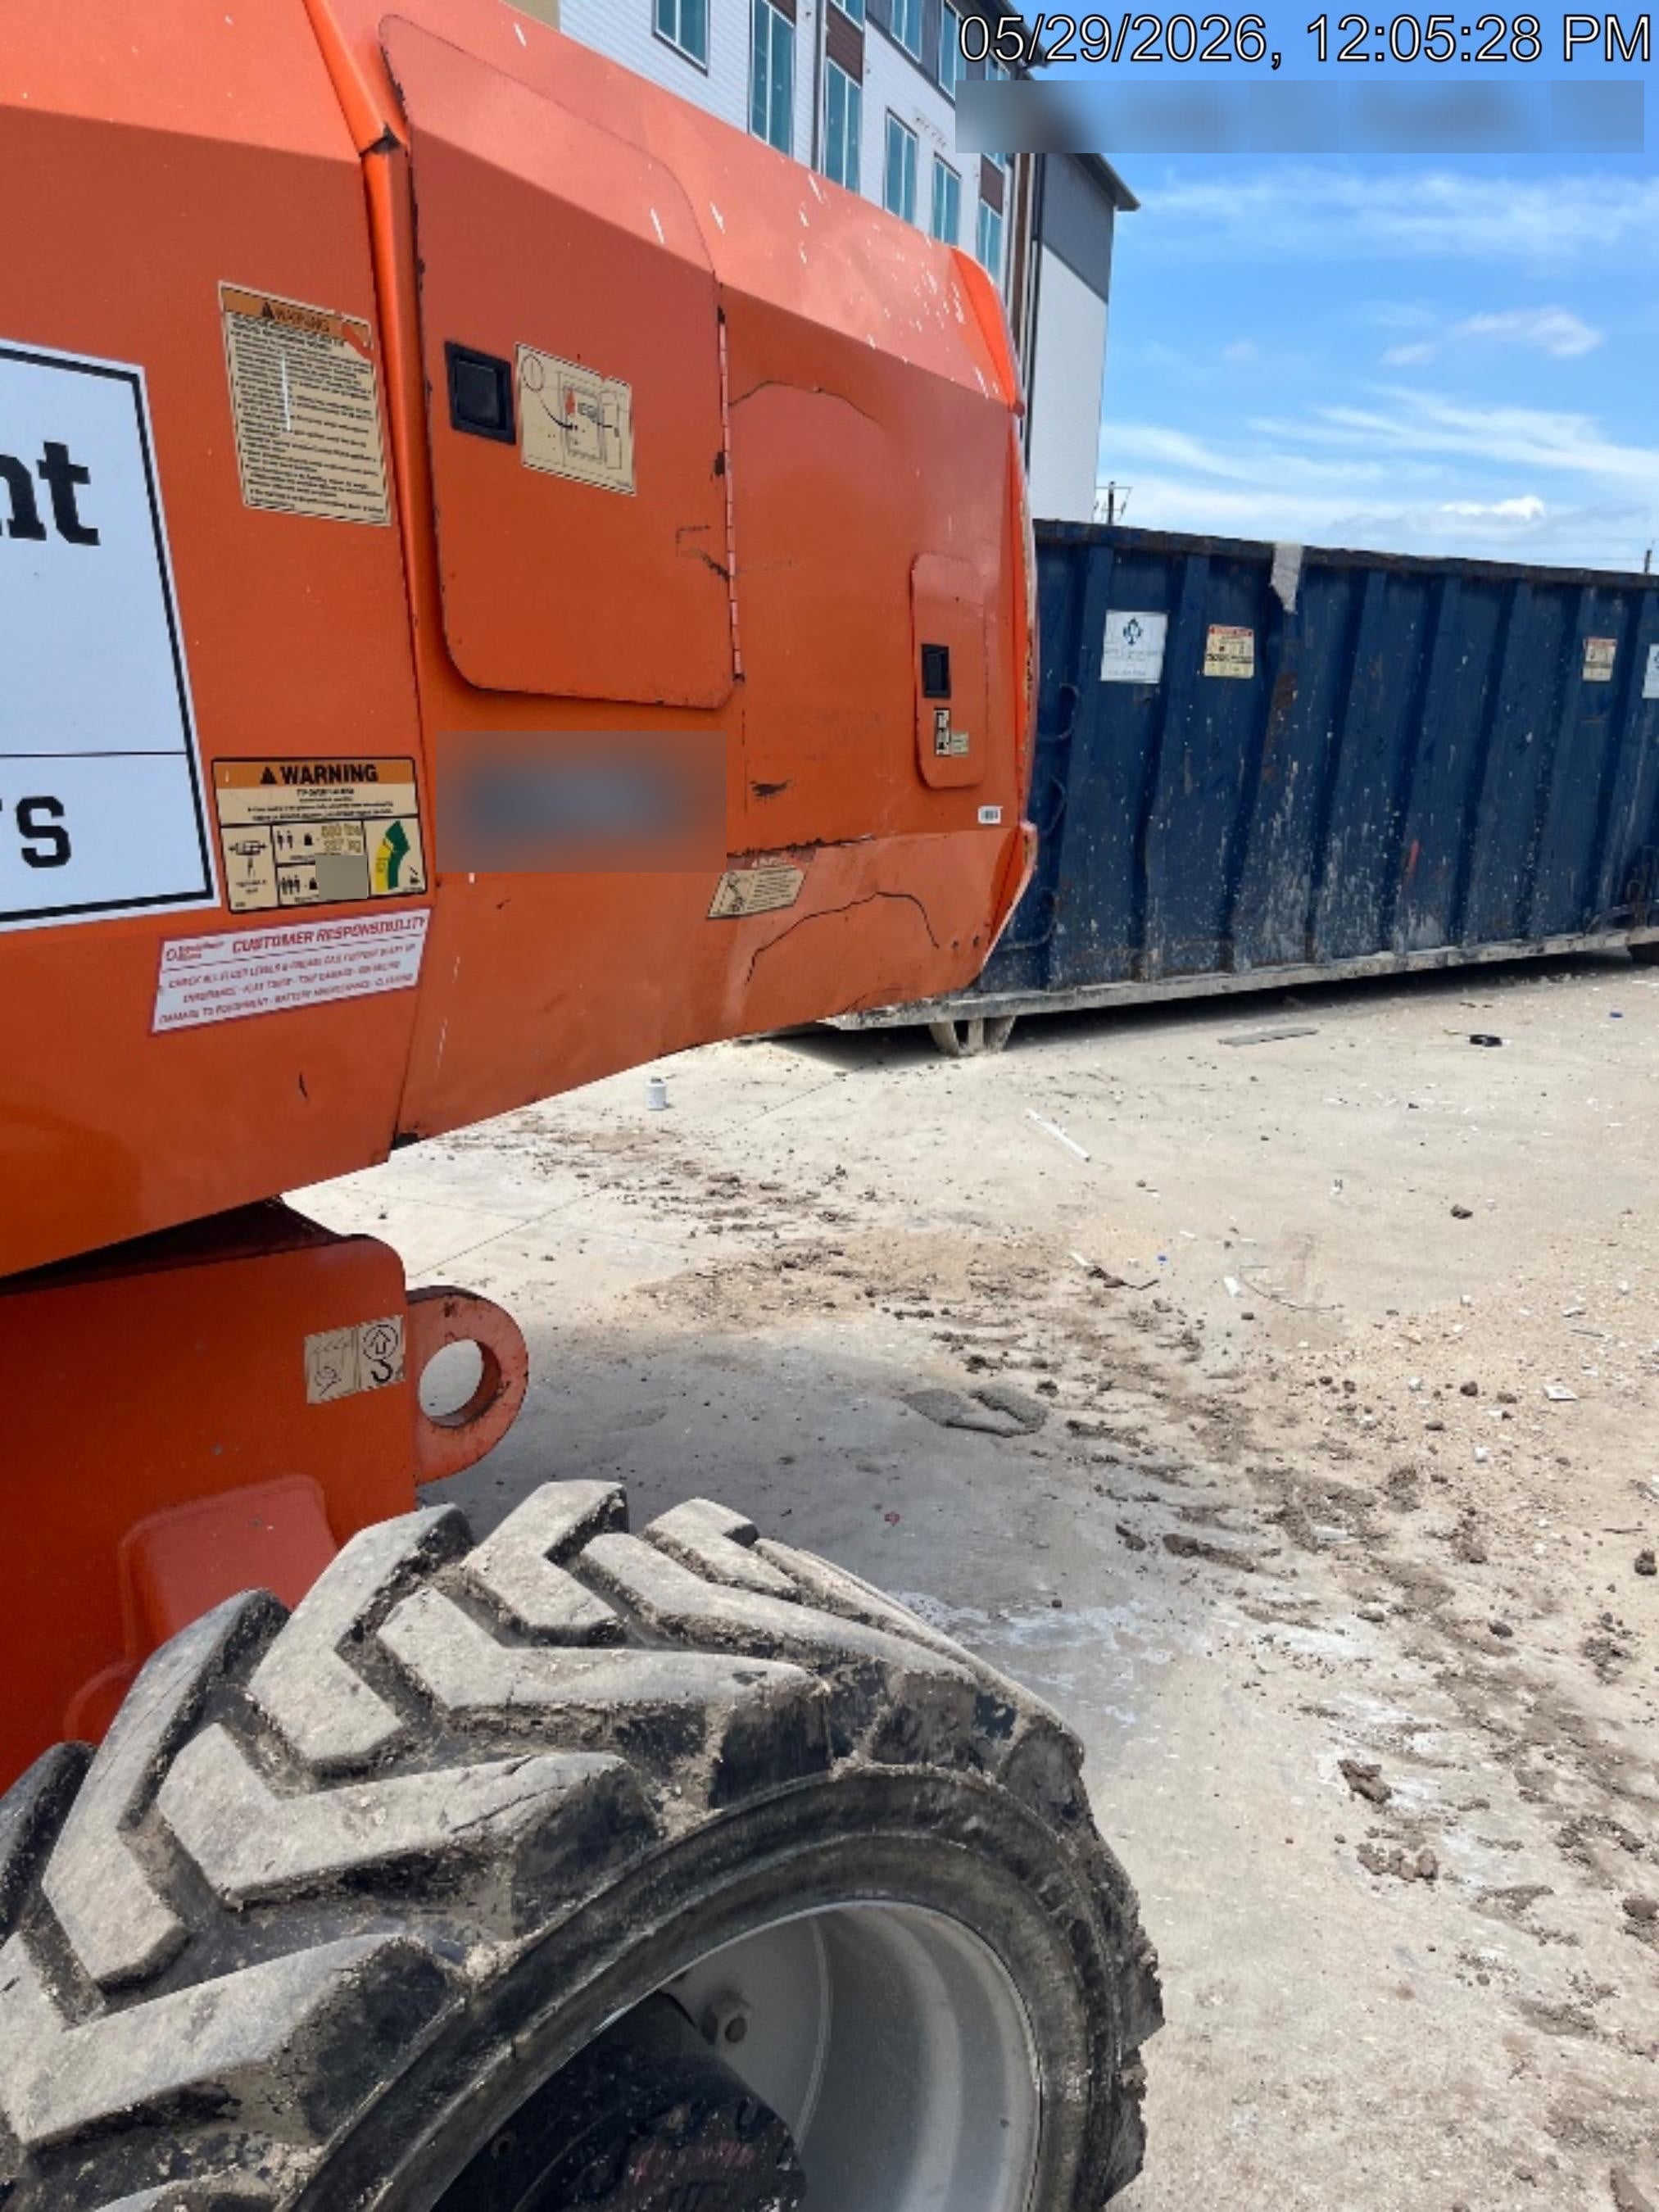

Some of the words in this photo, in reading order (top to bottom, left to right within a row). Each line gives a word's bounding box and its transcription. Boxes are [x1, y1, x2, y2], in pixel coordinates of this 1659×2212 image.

[279, 764, 379, 785] WARNING
[233, 931, 315, 954] CUSTOMER
[317, 916, 425, 941] RESPONSIBILITY
